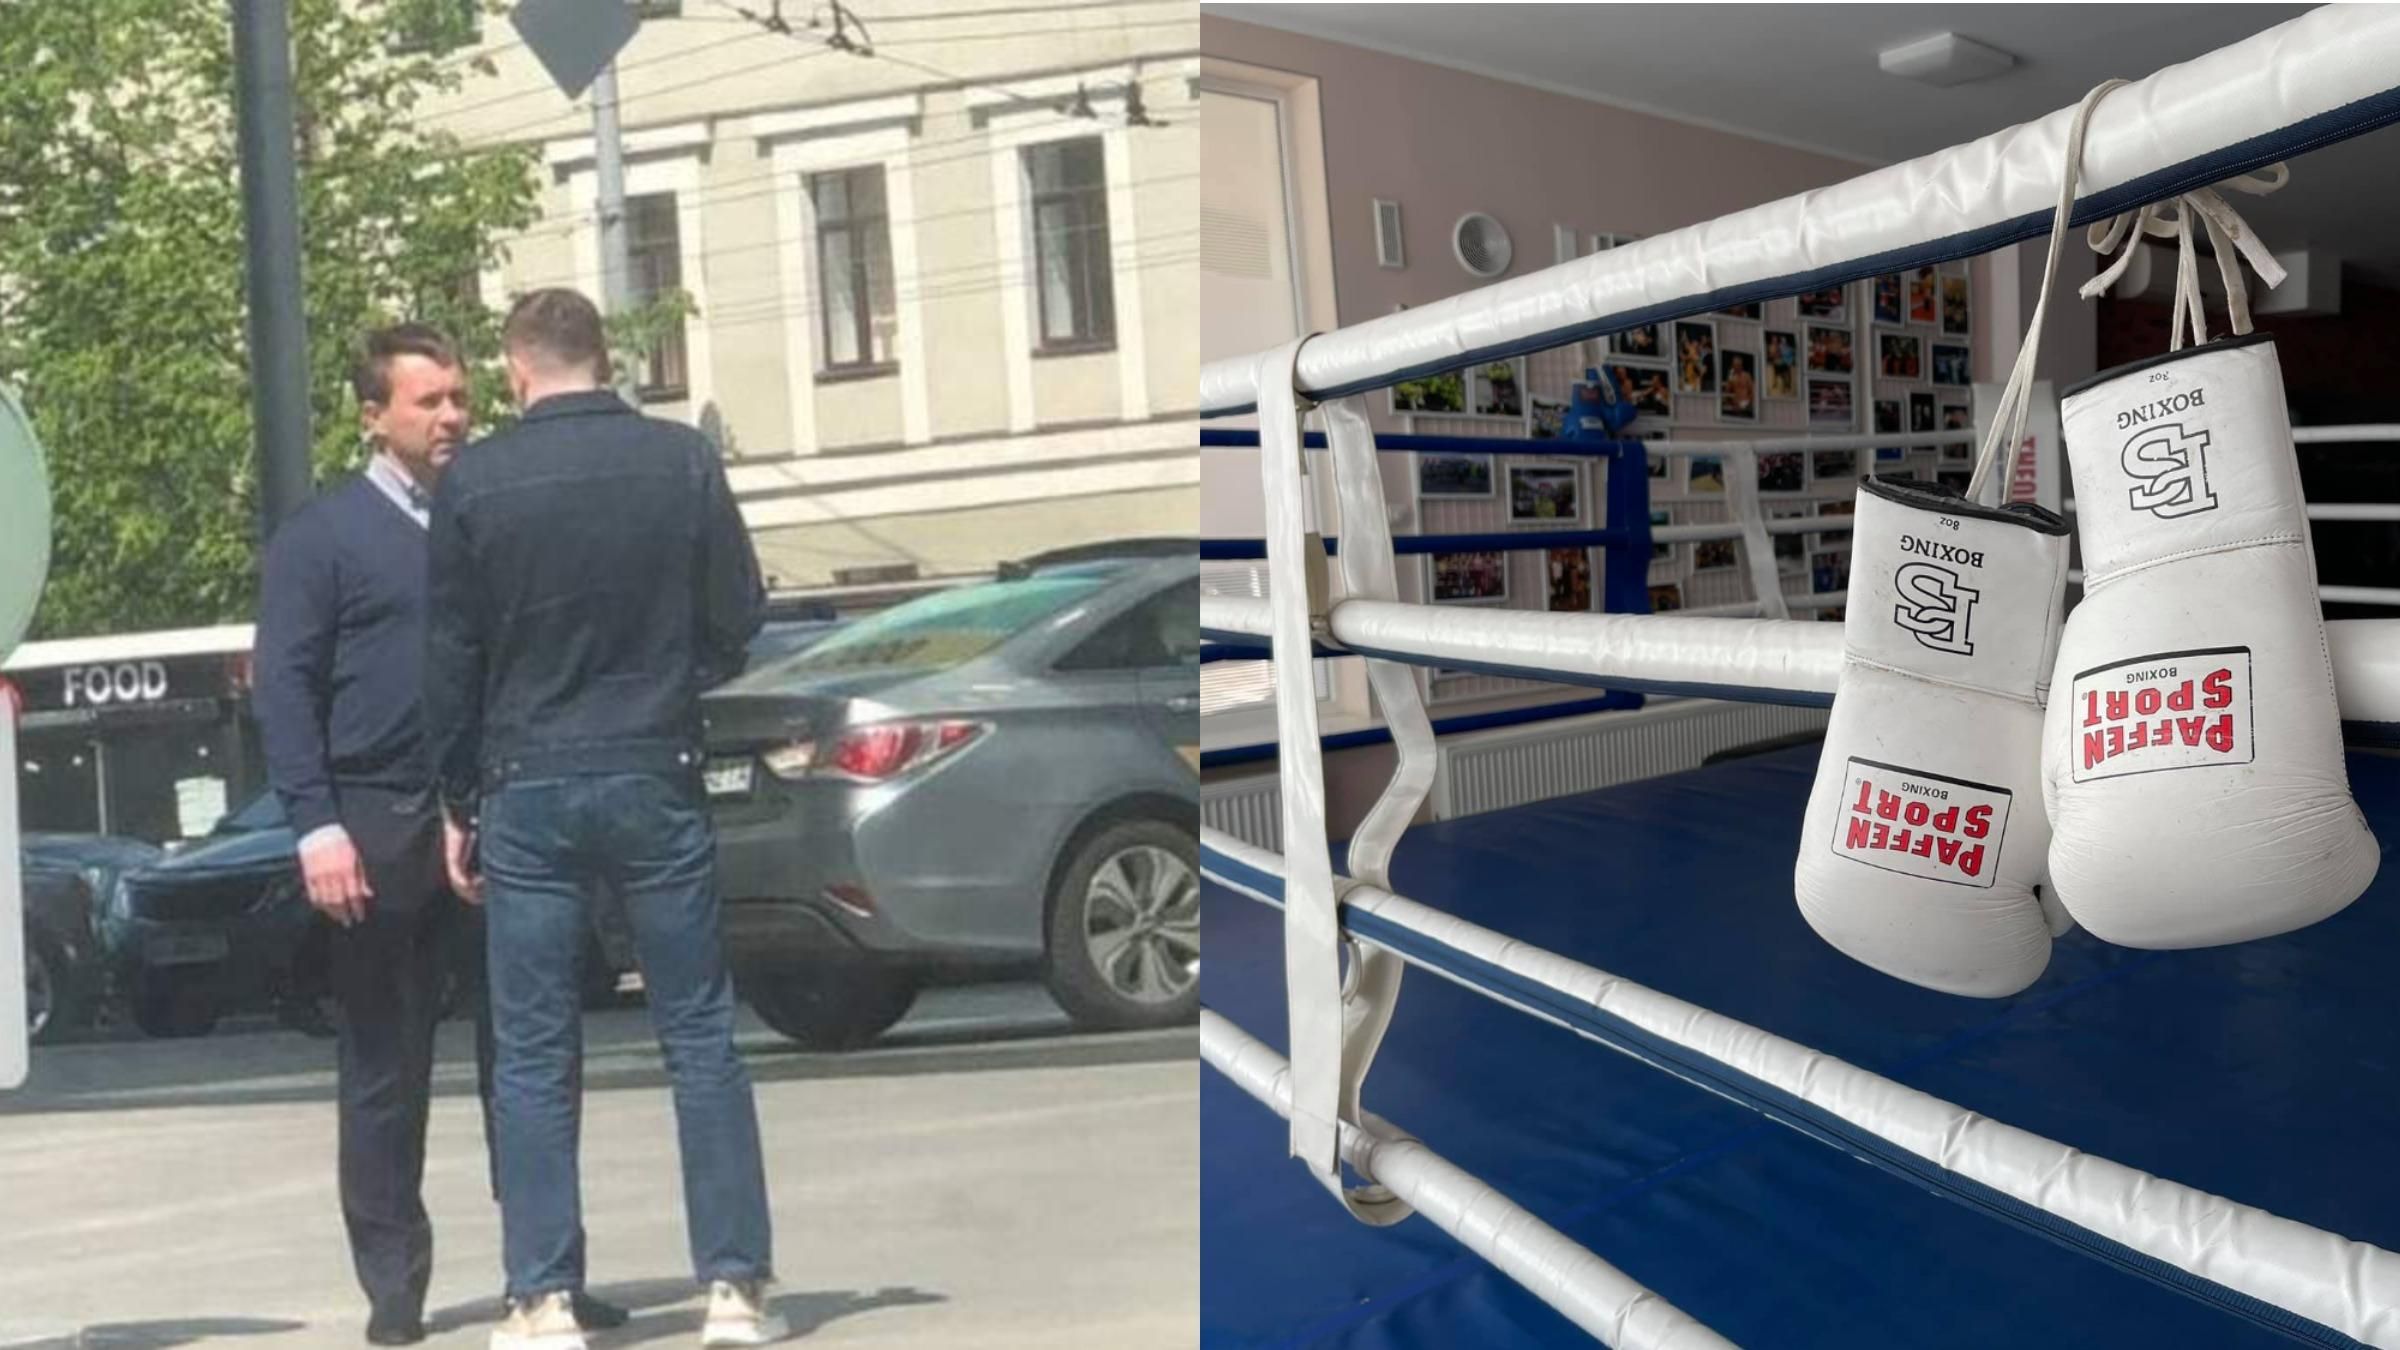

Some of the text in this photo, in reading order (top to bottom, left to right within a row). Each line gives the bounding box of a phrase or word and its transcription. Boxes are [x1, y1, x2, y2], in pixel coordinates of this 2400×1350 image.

[2116, 388, 2206, 430] BOXING
[1940, 516, 1960, 531] 8oz
[1900, 534, 1985, 568] BOXING
[63, 661, 168, 706] FOOD
[2126, 667, 2177, 684] BOXING
[2083, 668, 2233, 728] SPORT
[2083, 714, 2234, 770] PAFFEN
[1852, 780, 1994, 839] SPORT
[1901, 782, 1949, 800] BOXING
[1846, 816, 1985, 877] PAFFEN
